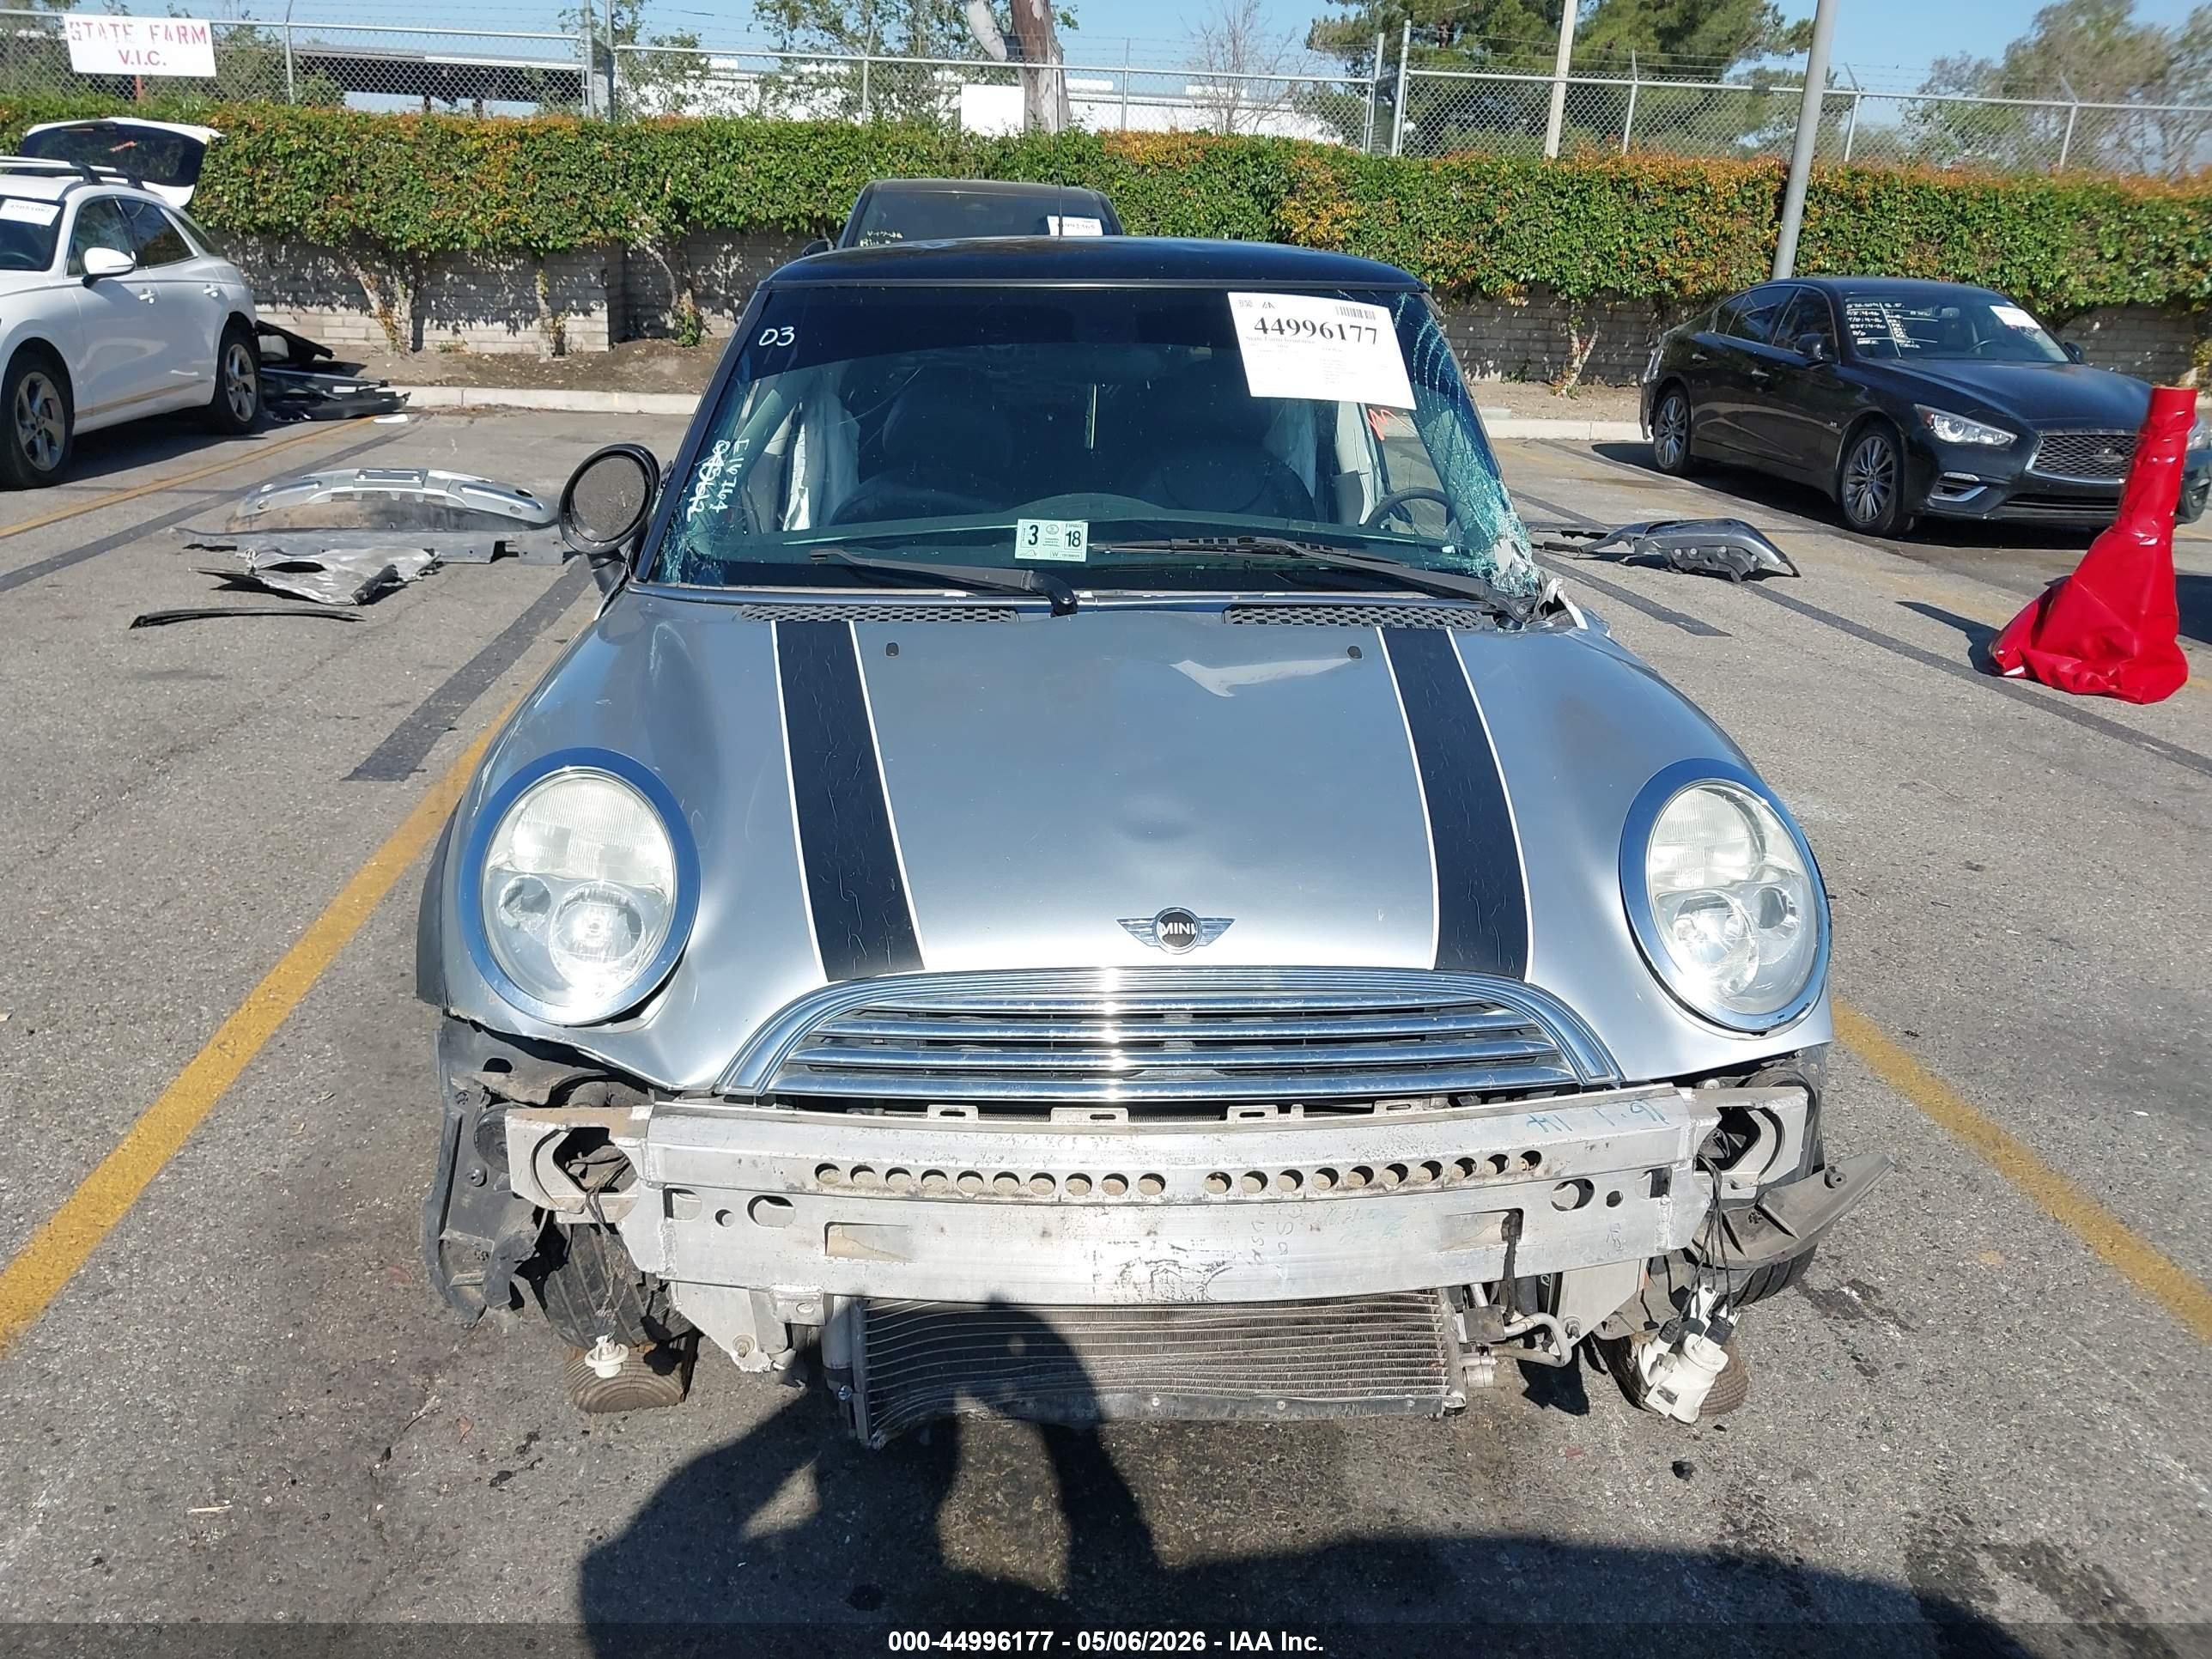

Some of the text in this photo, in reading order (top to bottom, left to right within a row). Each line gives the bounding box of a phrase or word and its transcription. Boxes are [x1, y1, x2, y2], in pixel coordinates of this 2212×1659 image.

[70, 21, 207, 45] STATE FARM
[118, 49, 167, 66] V.I.C.
[1255, 316, 1377, 344] 44996177
[1028, 525, 1039, 546] 3
[1066, 530, 1081, 547] 18
[1159, 921, 1196, 935] MINI
